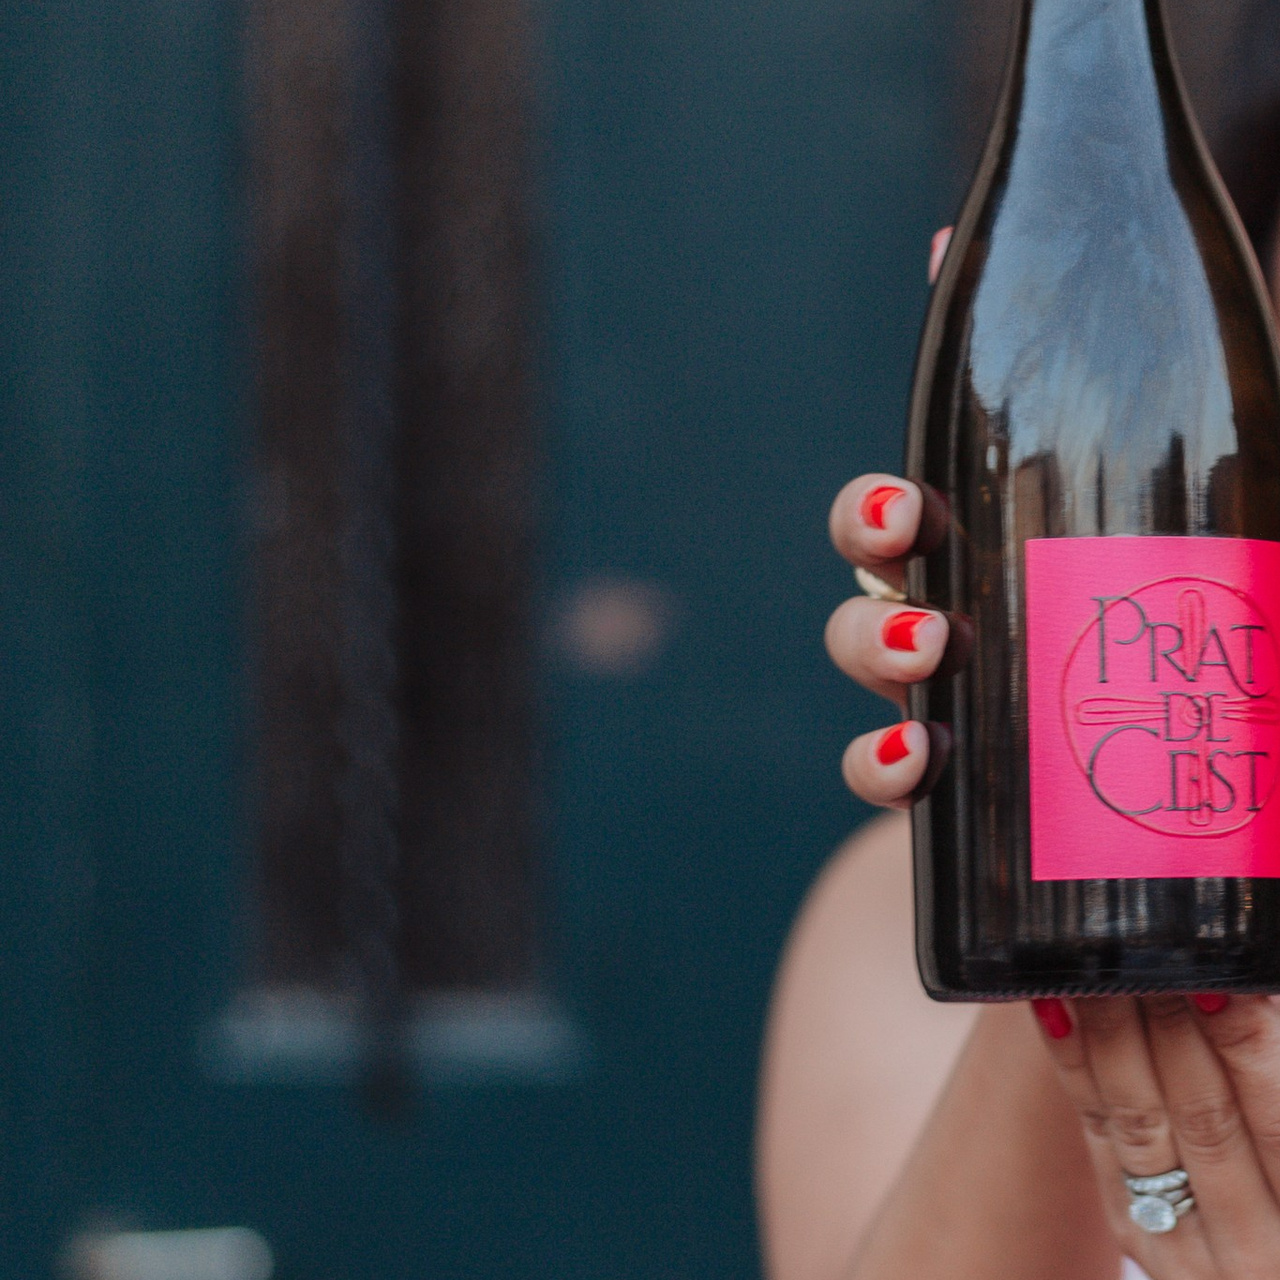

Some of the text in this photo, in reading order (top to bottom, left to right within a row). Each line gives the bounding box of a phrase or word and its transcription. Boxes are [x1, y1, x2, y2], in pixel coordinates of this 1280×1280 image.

[1091, 596, 1272, 698] PRAT
[1160, 691, 1231, 742] DE
[1088, 725, 1270, 816] CEST
